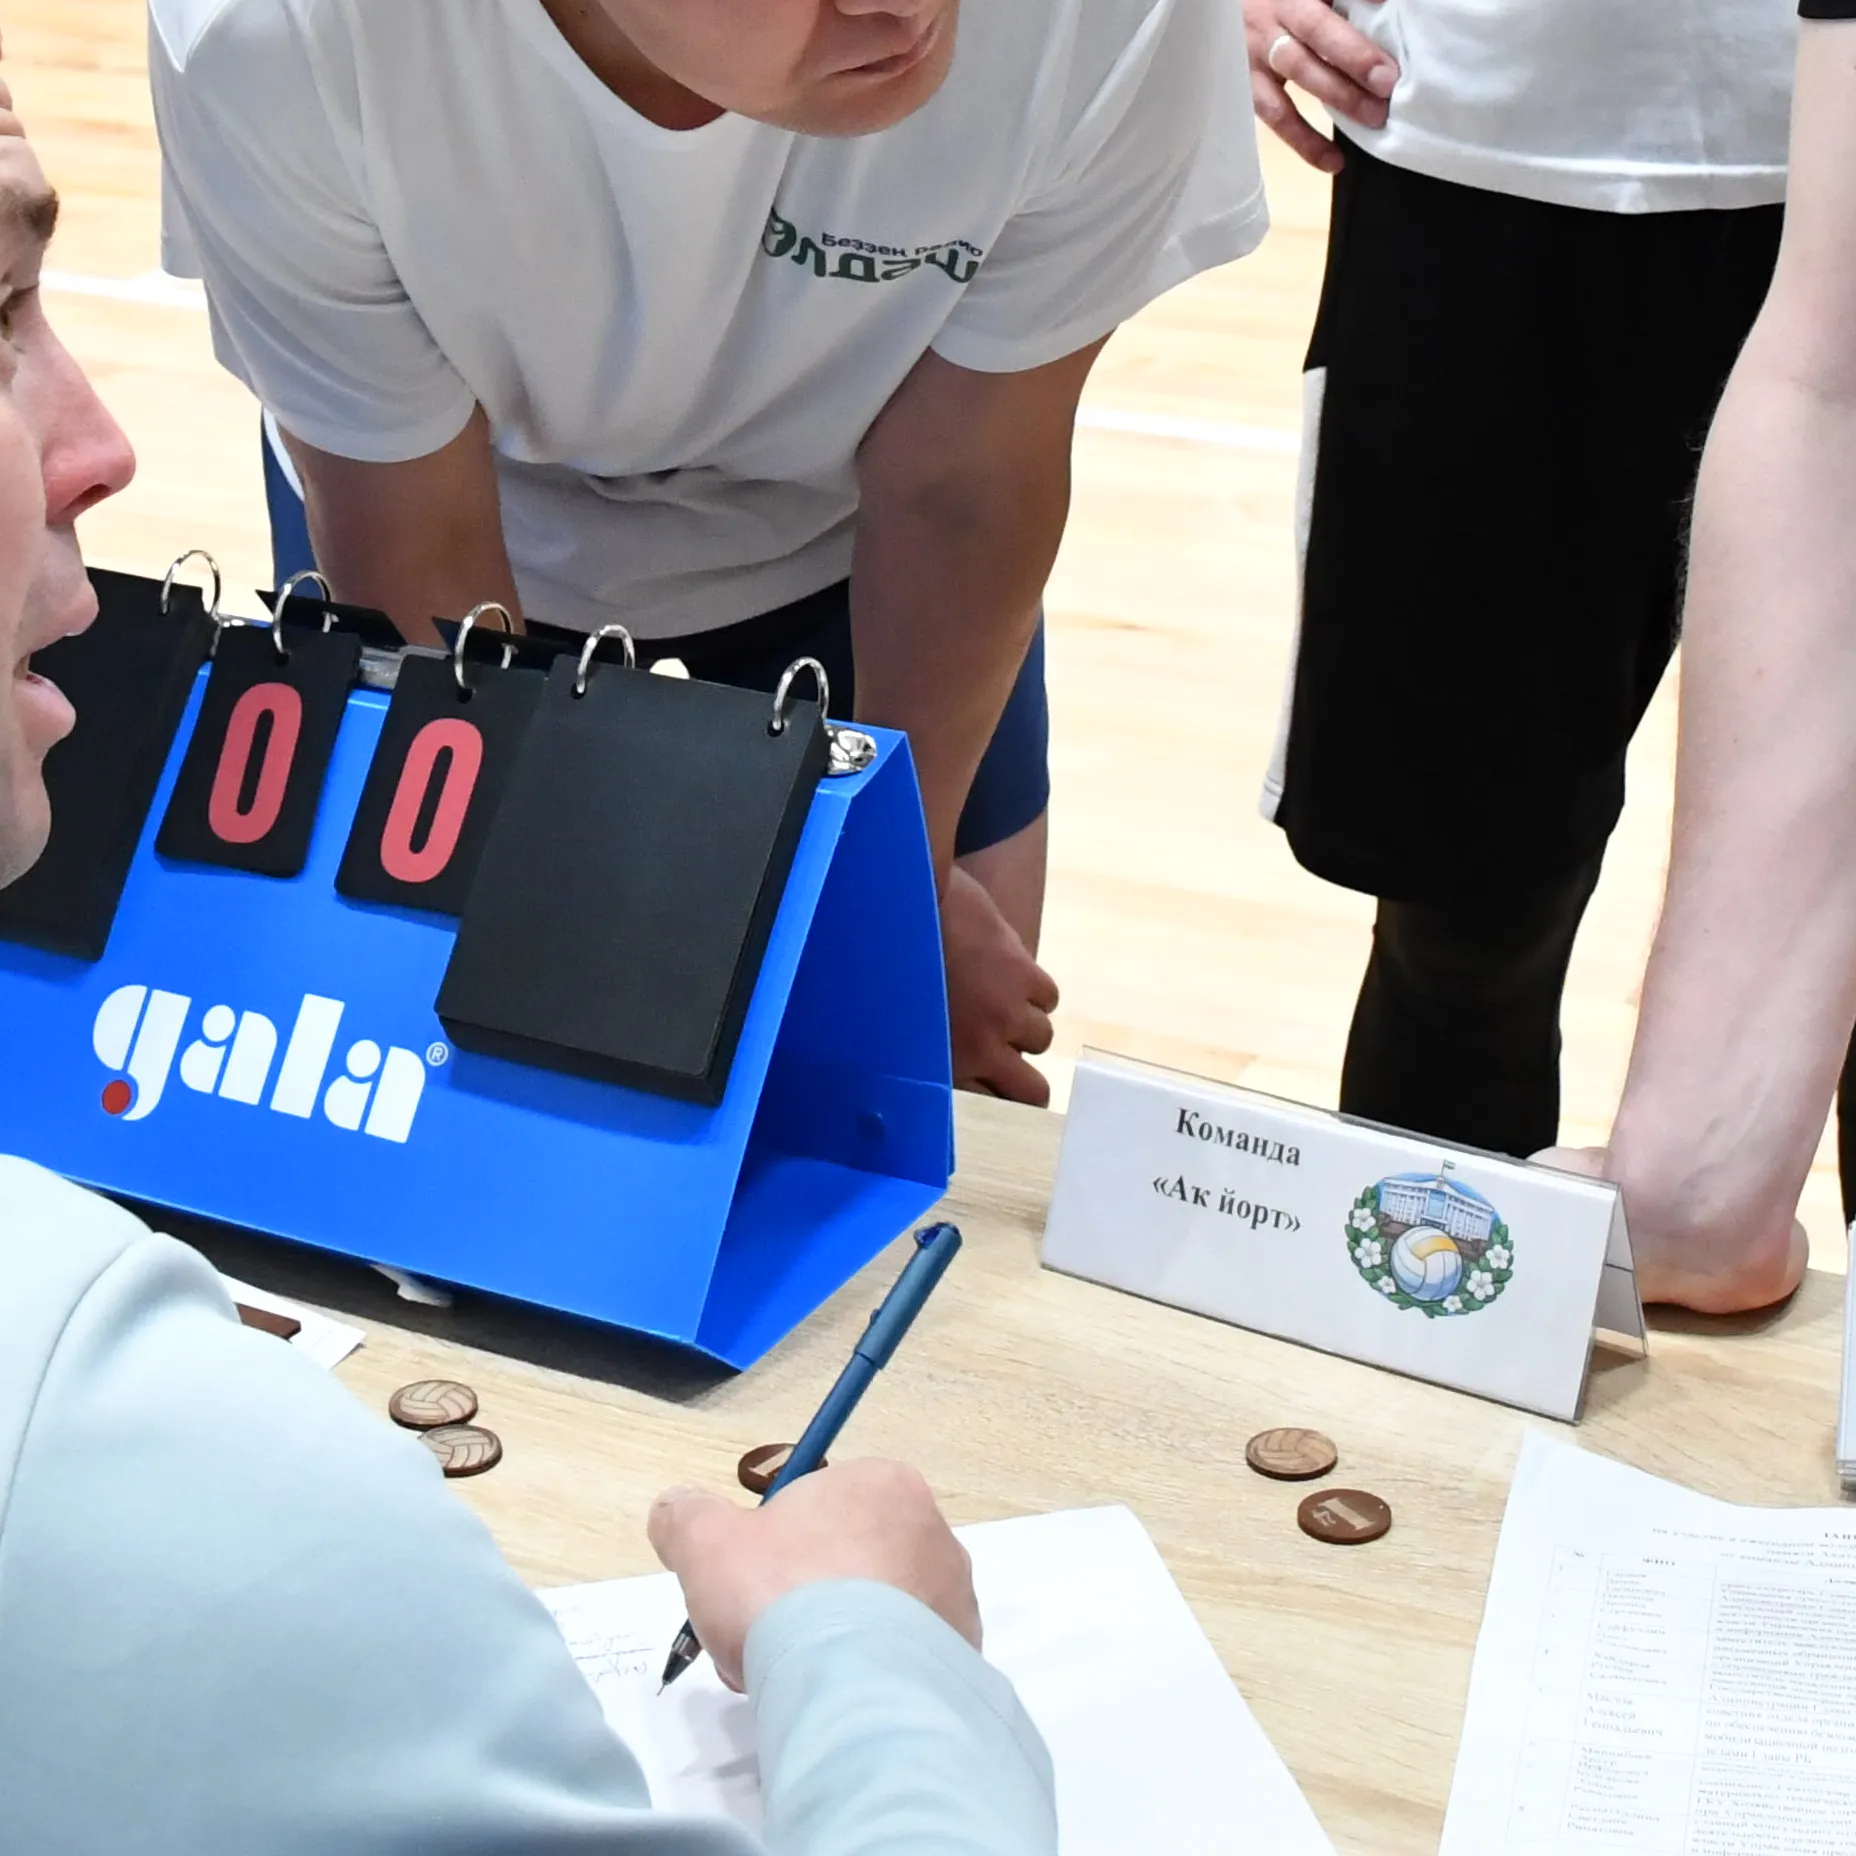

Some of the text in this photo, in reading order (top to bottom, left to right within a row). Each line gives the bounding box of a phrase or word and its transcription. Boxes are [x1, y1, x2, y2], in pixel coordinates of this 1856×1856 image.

[207, 681, 303, 845] 0
[379, 716, 484, 883] 0
[1174, 1106, 1302, 1167] Команда
[1151, 1174, 1302, 1234] «Ак йорт»
